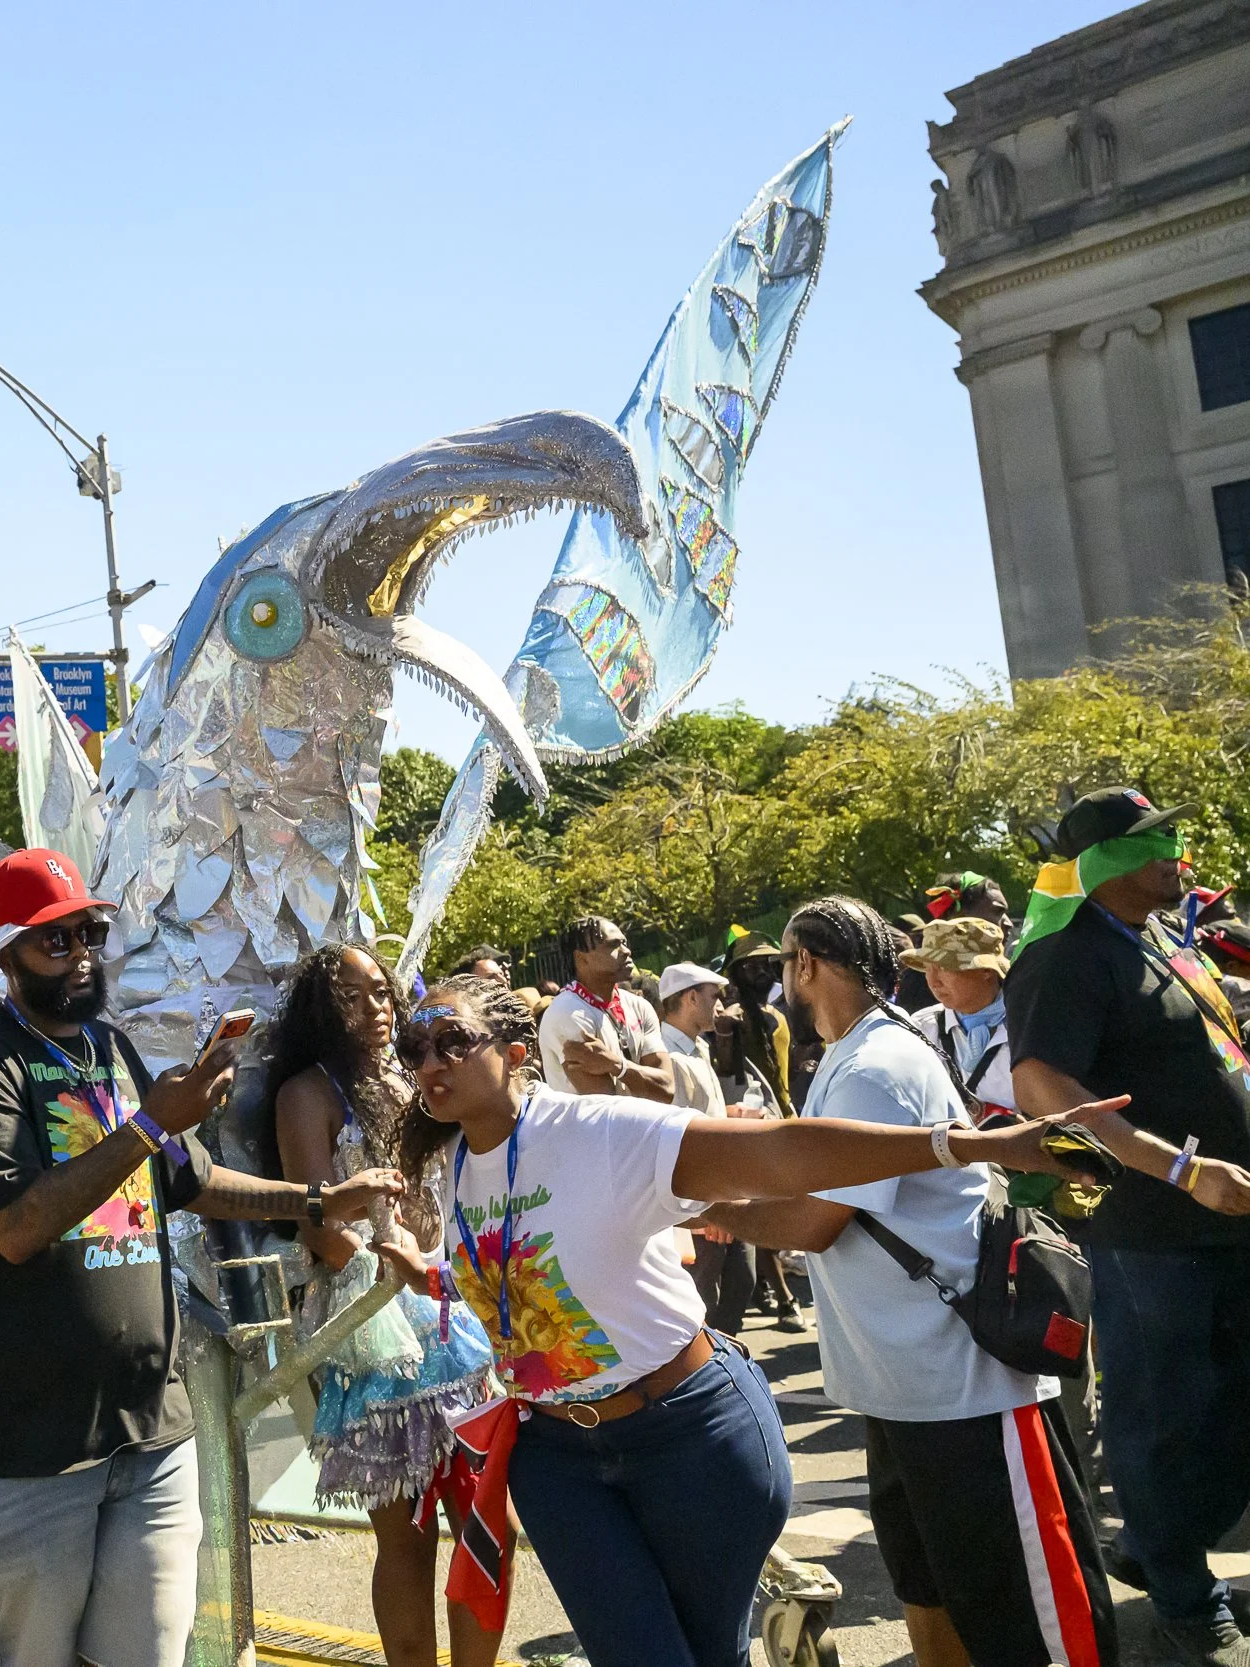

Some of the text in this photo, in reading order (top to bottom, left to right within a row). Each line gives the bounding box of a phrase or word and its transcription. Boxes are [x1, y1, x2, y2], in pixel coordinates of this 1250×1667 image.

[53, 667, 92, 683] Brooklyn
[56, 683, 92, 695] Museum
[63, 698, 87, 711] of Art
[489, 1184, 553, 1220] Islands
[85, 1245, 125, 1270] One
